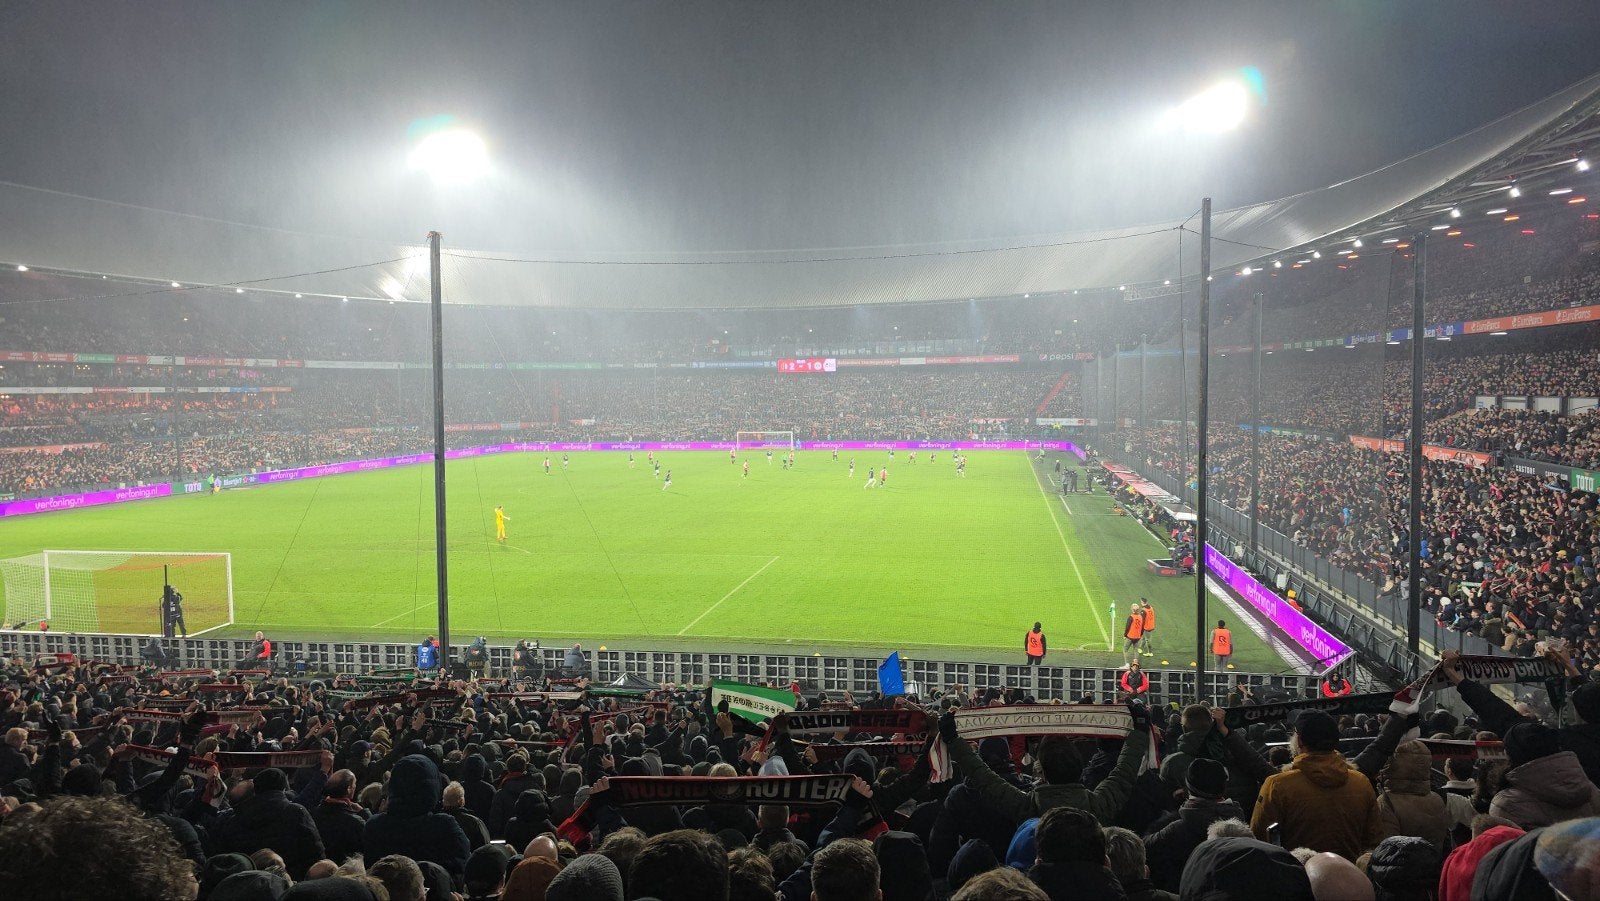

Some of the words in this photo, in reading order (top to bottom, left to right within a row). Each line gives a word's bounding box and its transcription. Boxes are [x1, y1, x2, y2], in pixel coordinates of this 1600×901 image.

[1049, 352, 1075, 361] pepsi
[184, 482, 202, 494] TOTO
[1576, 474, 1594, 492] TOTO
